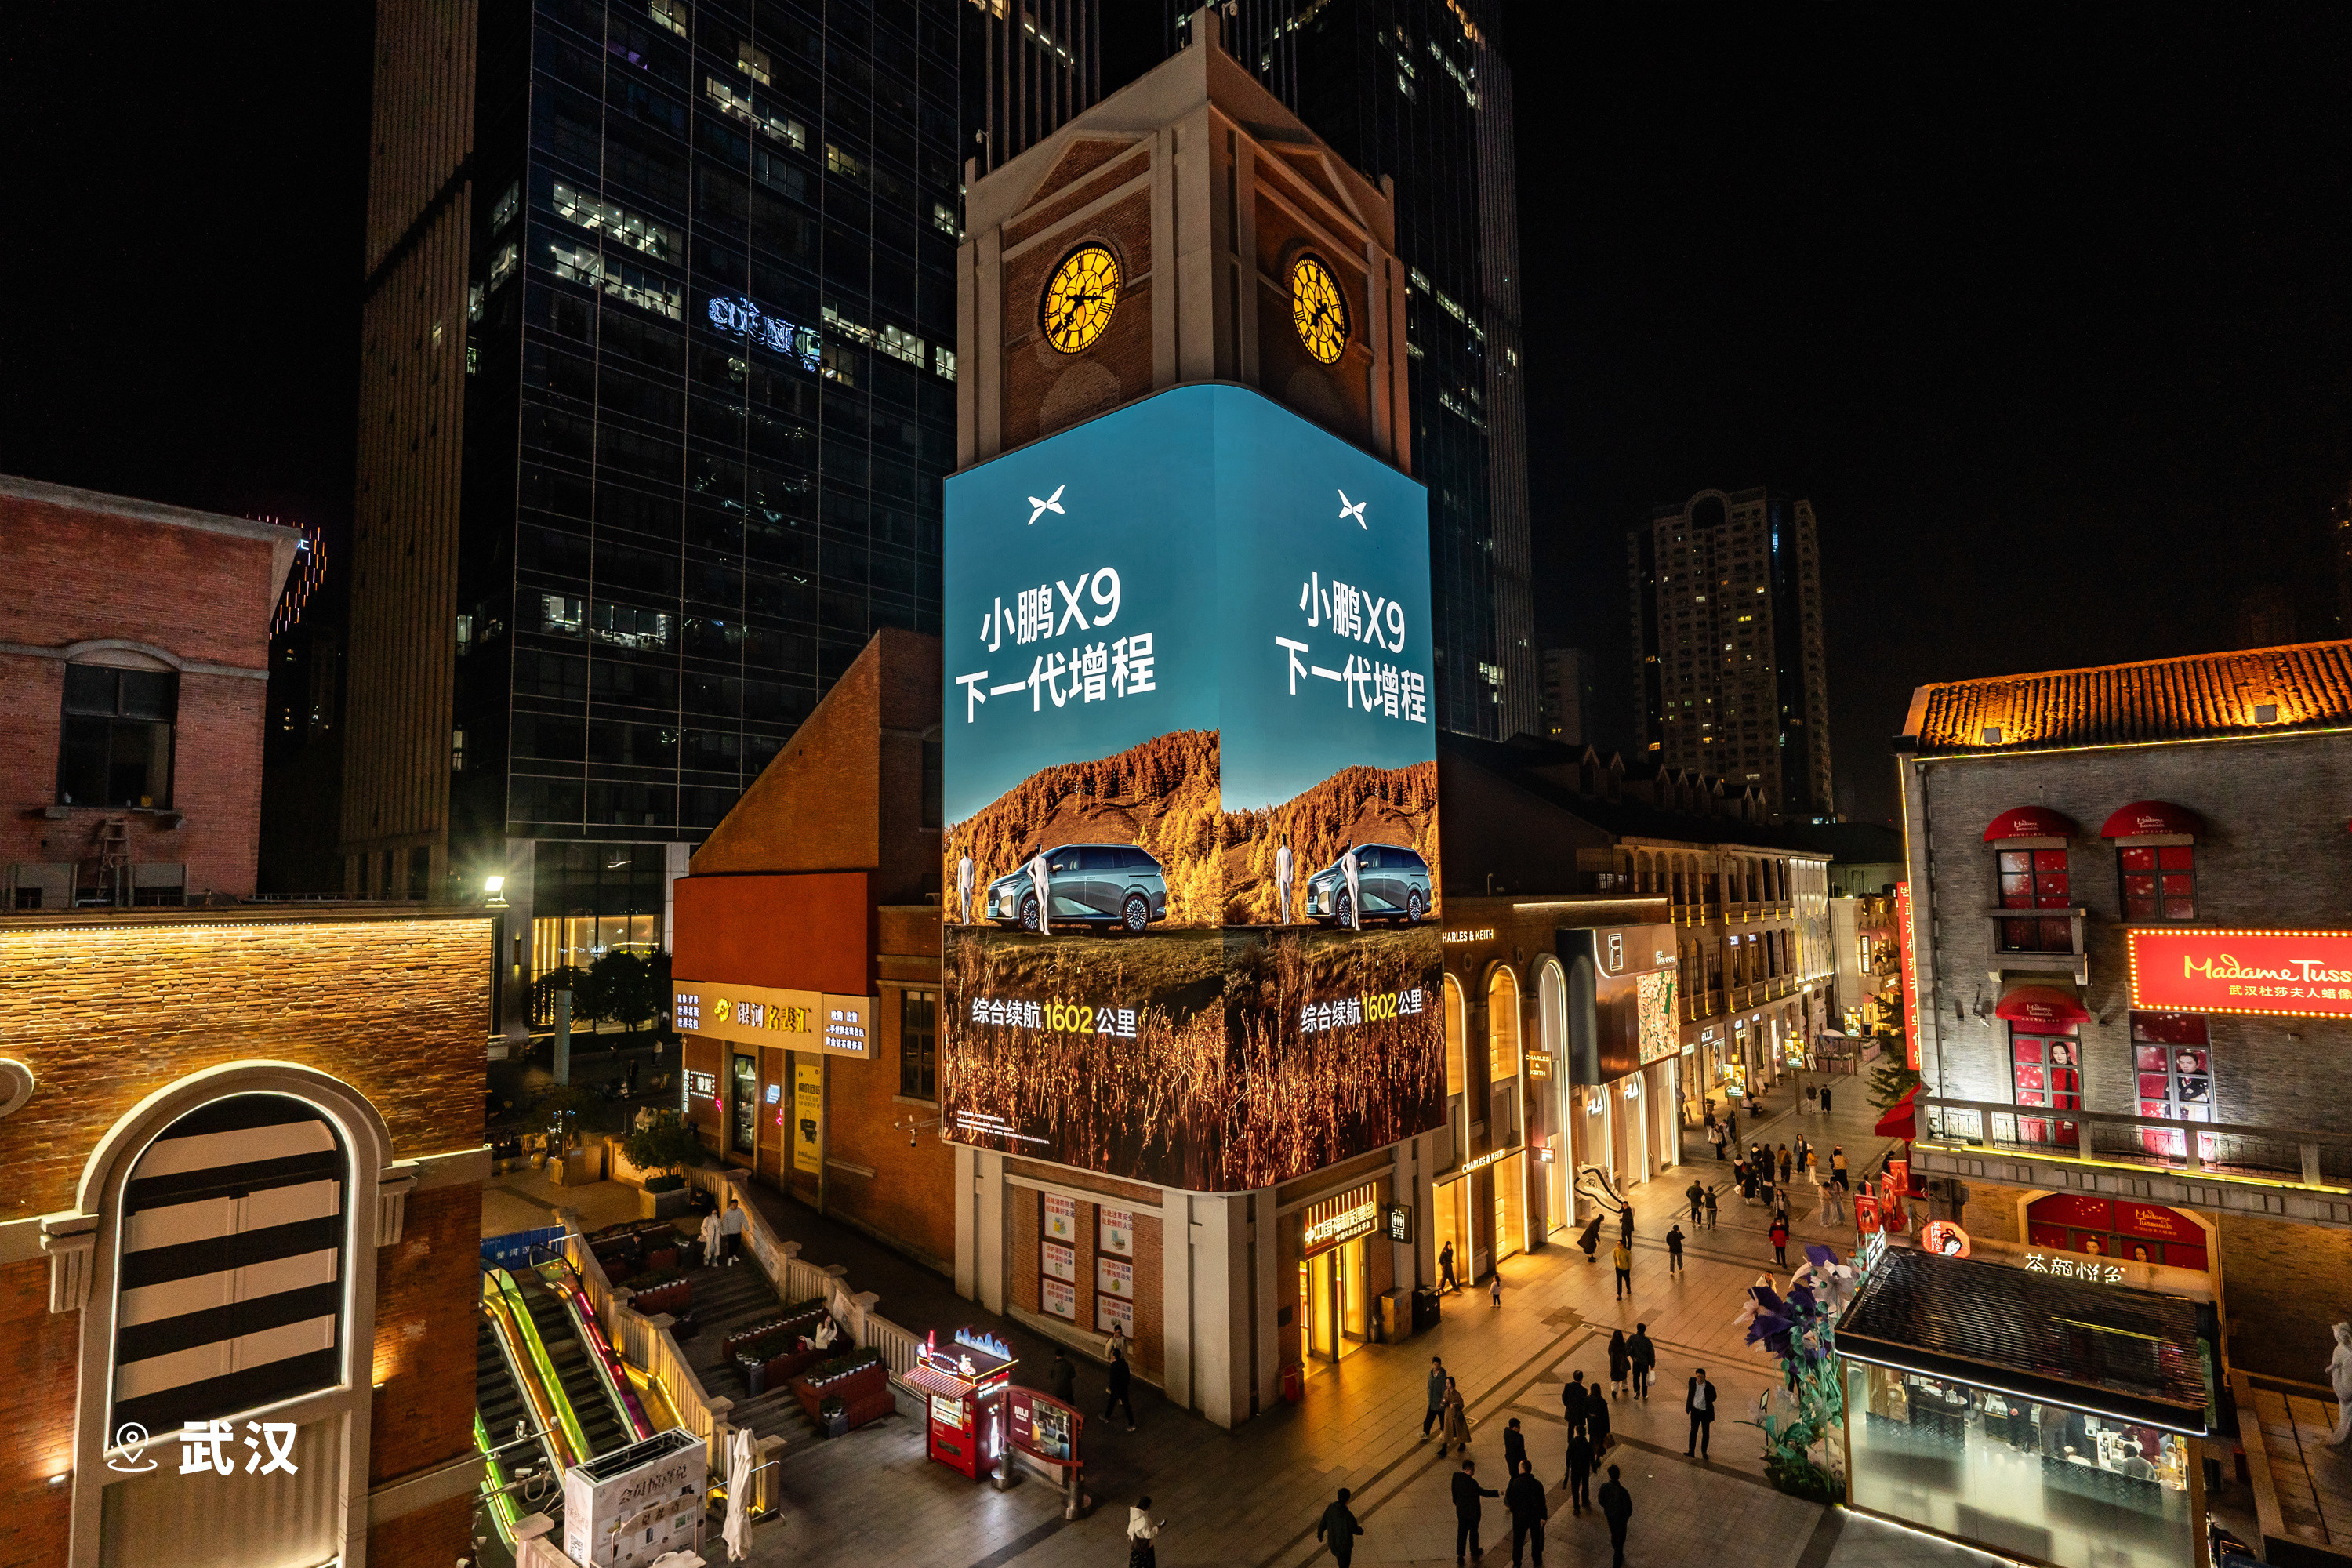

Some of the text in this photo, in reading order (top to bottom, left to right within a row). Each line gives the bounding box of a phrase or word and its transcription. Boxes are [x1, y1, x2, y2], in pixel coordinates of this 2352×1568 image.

[980, 567, 1121, 652] 小鹏X9
[1299, 571, 1406, 653] 小鹏X9
[956, 632, 1156, 724] 下一代增程
[1276, 636, 1427, 724] 下一代增程
[1468, 930, 1475, 942] &
[1475, 928, 1494, 941] KEITH
[2183, 953, 2300, 982] Madame
[677, 1005, 699, 1018] 世界名表
[737, 1001, 812, 1033] 银河名表汇
[677, 1018, 699, 1029] 世界名包
[1701, 1029, 1713, 1043] ELLE
[1735, 1029, 1746, 1040] ELLE
[1624, 1082, 1639, 1100] FILA
[1586, 1096, 1604, 1117] FILA
[1461, 1148, 1506, 1174] CHARLES & KEITH
[1314, 1204, 1366, 1240] 中国福利彩票
[2135, 1217, 2172, 1229] Tussauds
[2136, 1209, 2173, 1222] Madame
